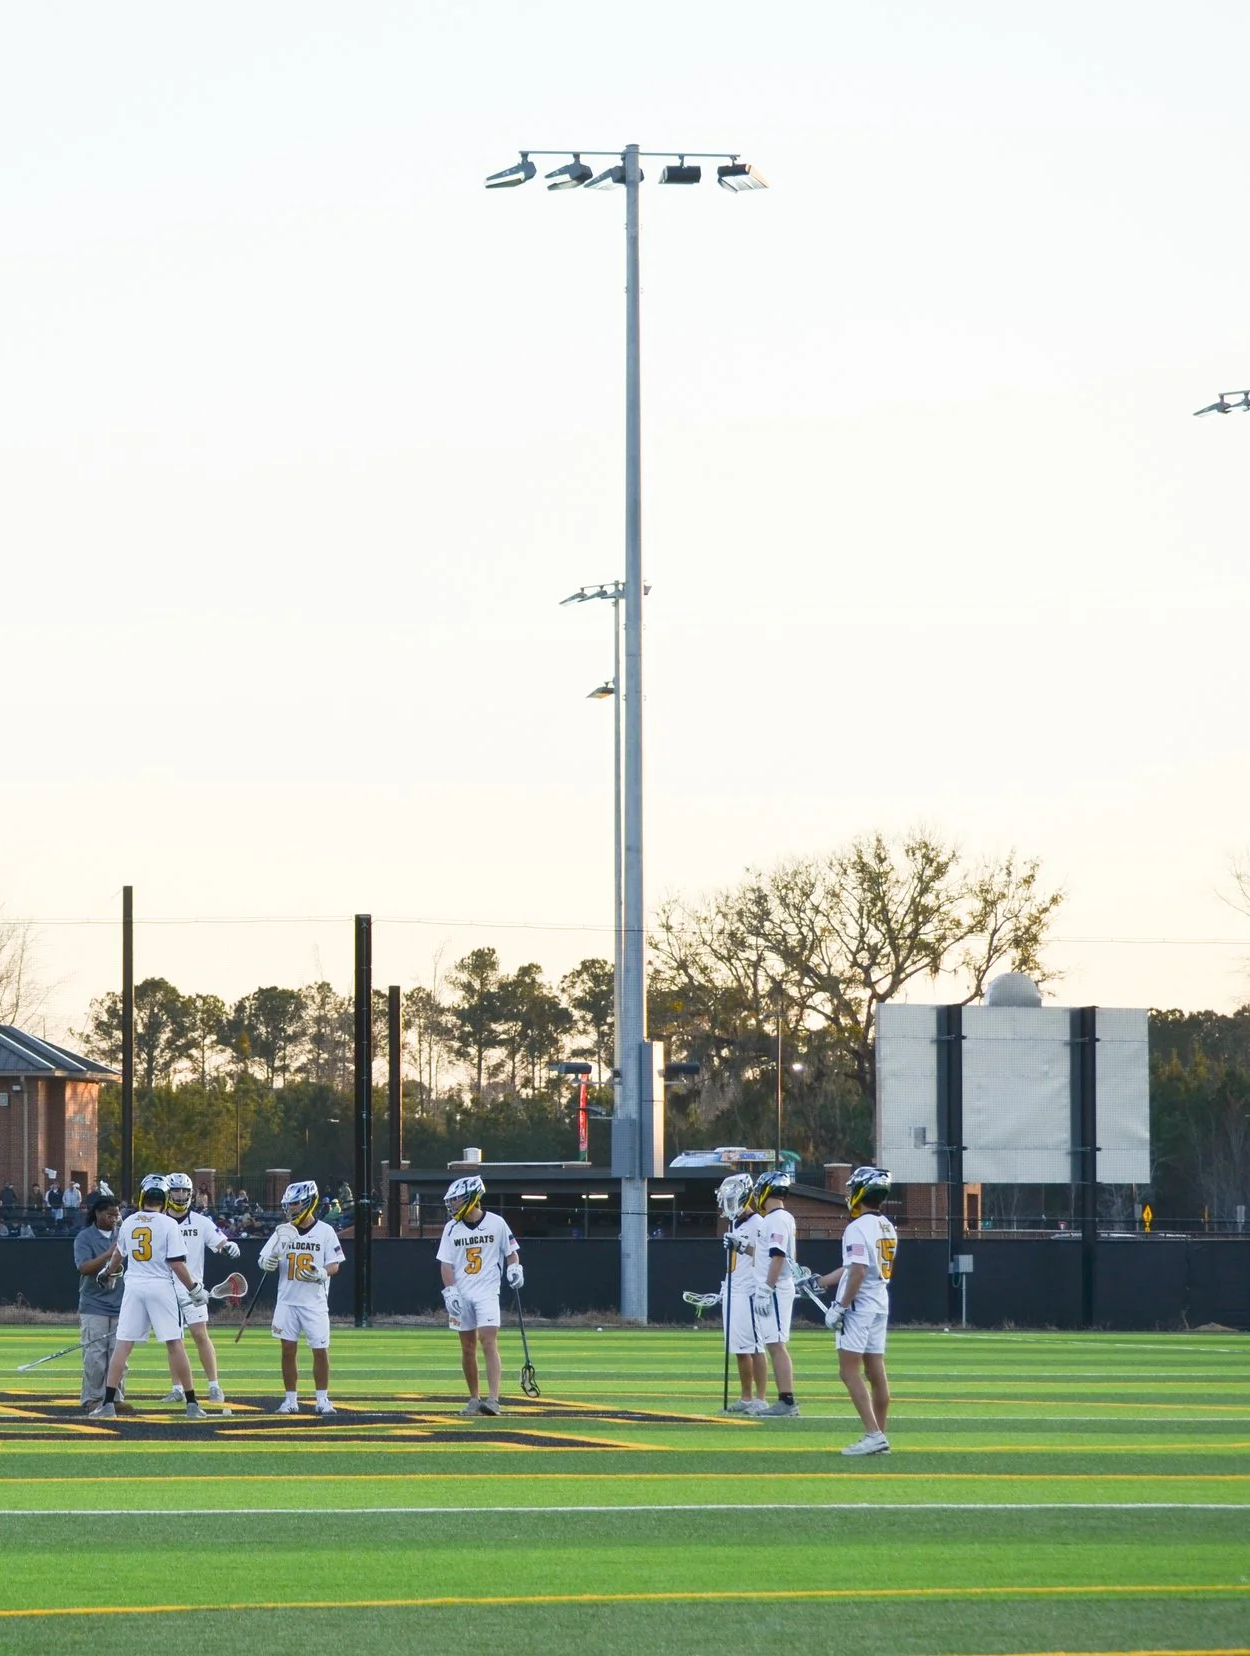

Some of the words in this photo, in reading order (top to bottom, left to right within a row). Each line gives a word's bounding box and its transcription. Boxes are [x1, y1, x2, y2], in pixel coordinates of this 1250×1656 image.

[132, 1226, 153, 1262] 3
[453, 1234, 495, 1247] WILDCATS
[286, 1251, 315, 1282] 18
[463, 1246, 483, 1275] 5
